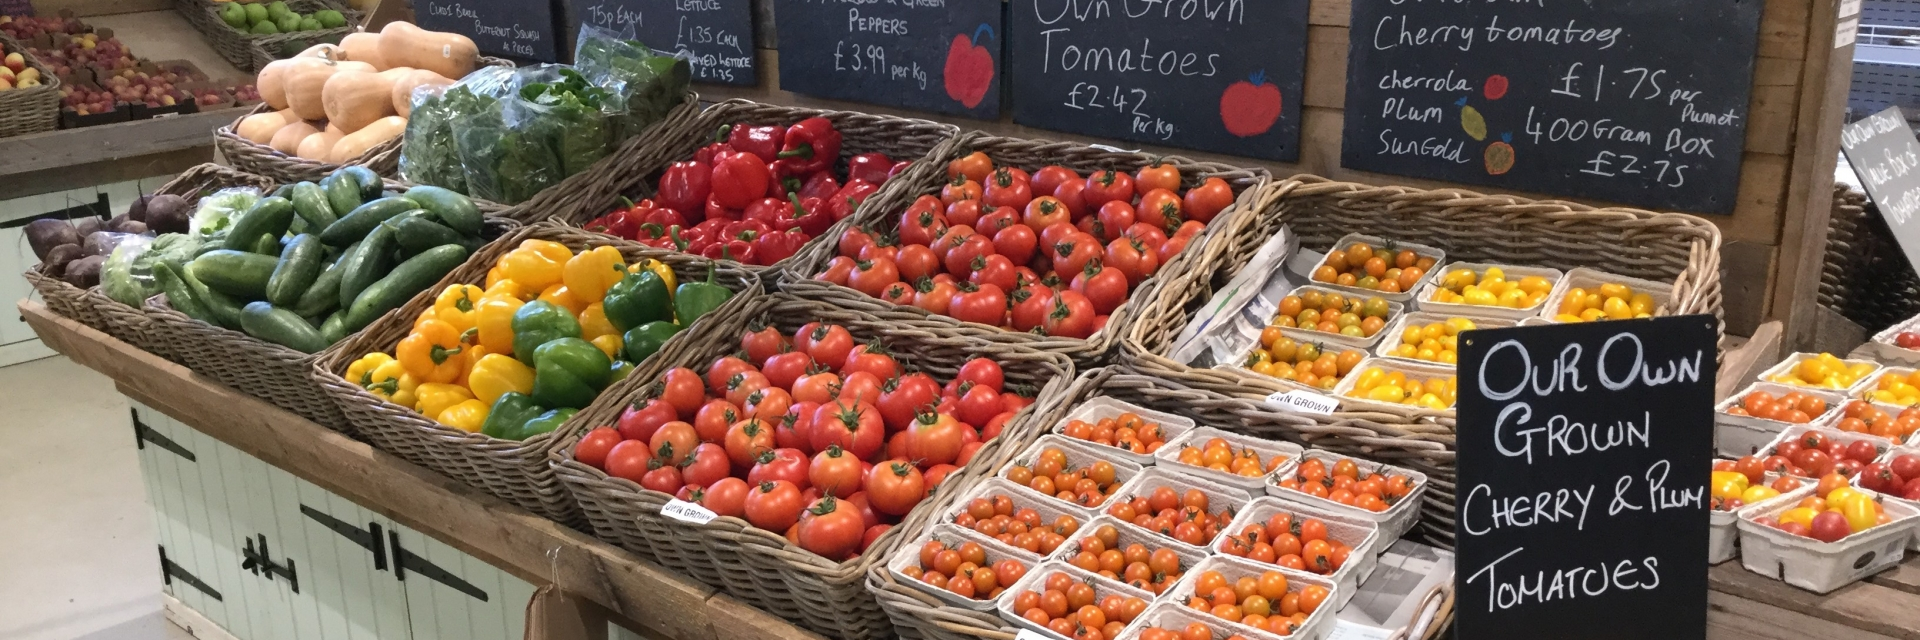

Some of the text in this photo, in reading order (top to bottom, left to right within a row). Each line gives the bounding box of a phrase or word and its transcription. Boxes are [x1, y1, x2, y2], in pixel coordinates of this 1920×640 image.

[616, 4, 643, 28] EACH
[849, 7, 908, 35] PEPPERS
[1373, 14, 1474, 51] Cherry
[716, 30, 743, 54] EACH
[834, 40, 886, 75] £3.99
[891, 64, 910, 80] per
[1040, 27, 1220, 77] Tomatoes
[1669, 88, 1703, 106] per
[1478, 331, 1702, 401] OUR OWN
[1293, 396, 1331, 412] GROWN
[1494, 401, 1650, 465] GROWN
[1462, 459, 1705, 536] CHERRY & PLUM
